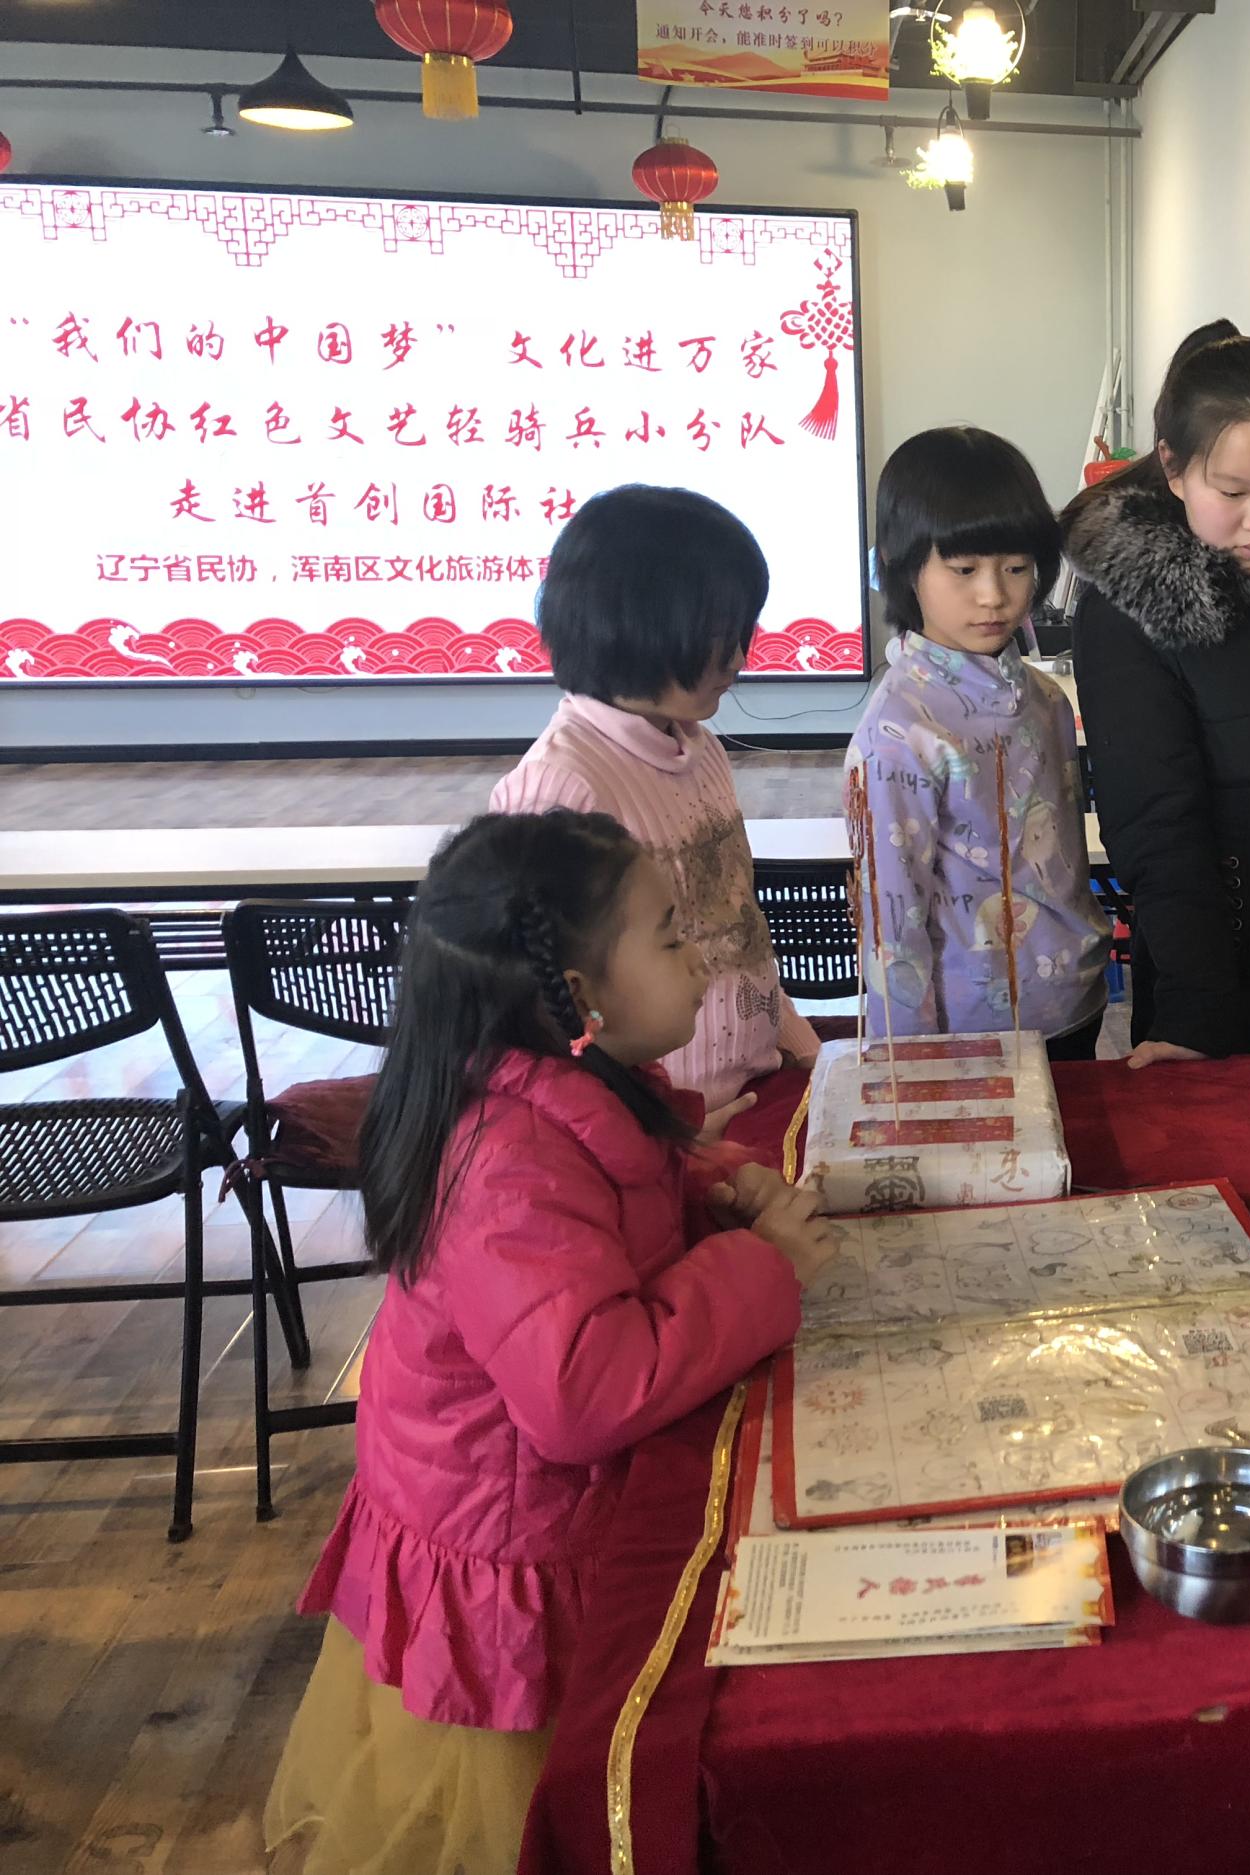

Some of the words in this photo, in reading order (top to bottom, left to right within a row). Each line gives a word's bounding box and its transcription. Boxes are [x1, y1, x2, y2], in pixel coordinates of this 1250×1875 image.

[506, 329, 780, 379] 文化进万家
[0, 395, 786, 452] 省民协红色文艺轻骑兵小分队
[169, 478, 577, 527] 走进首创国际社
